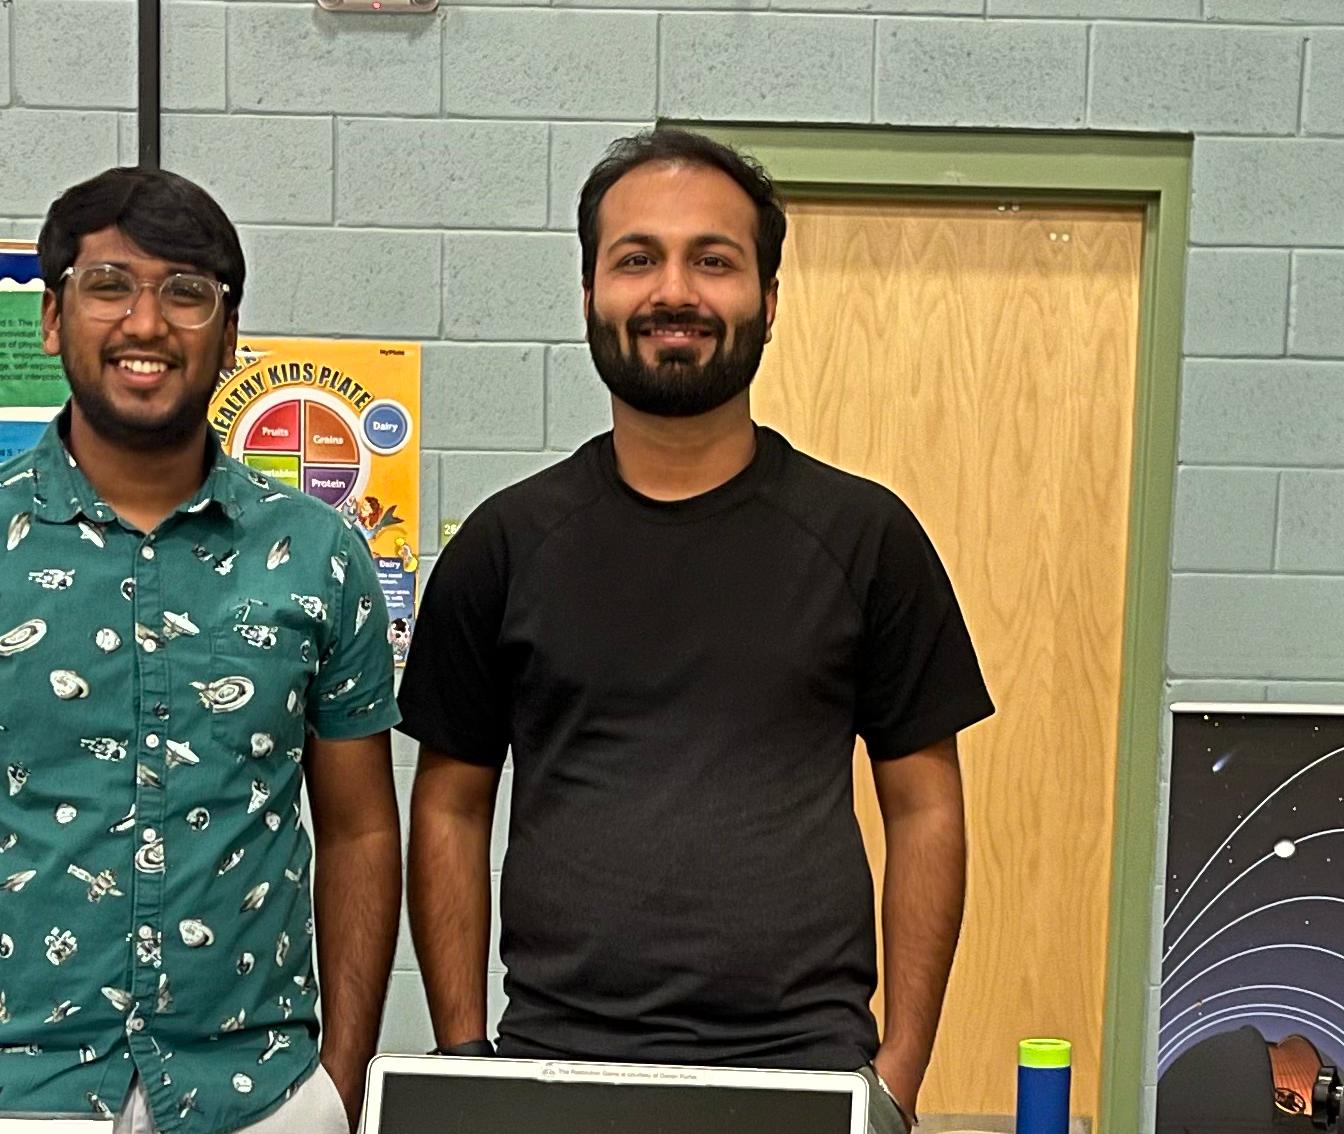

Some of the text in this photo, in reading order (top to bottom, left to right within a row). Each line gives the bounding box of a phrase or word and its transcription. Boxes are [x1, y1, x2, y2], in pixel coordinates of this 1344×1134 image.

[268, 363, 314, 386] KIDS
[319, 366, 371, 409] PLATE
[262, 427, 289, 437] Fruits
[373, 422, 398, 432] Dairy
[313, 434, 344, 444] Grains
[312, 478, 346, 488] Protein
[379, 560, 401, 569] Dairy
